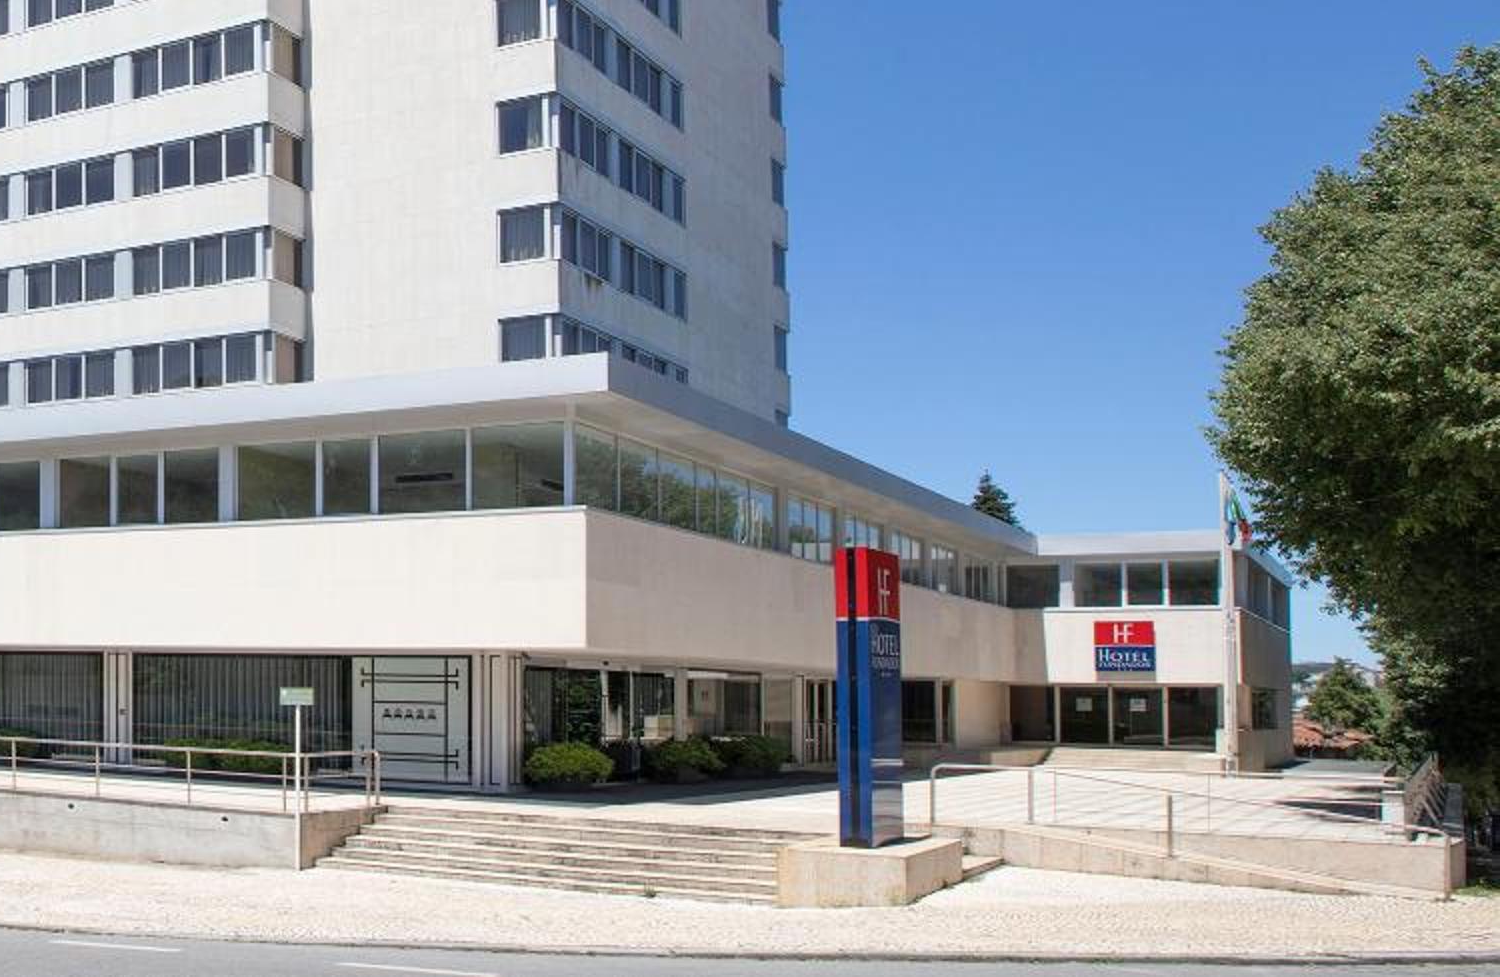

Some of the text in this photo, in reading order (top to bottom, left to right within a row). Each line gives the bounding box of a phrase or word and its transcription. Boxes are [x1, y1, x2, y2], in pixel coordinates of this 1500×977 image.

[871, 628, 899, 656] HOTEL
[1113, 623, 1135, 644] HF
[1099, 648, 1150, 662] HOTEL
